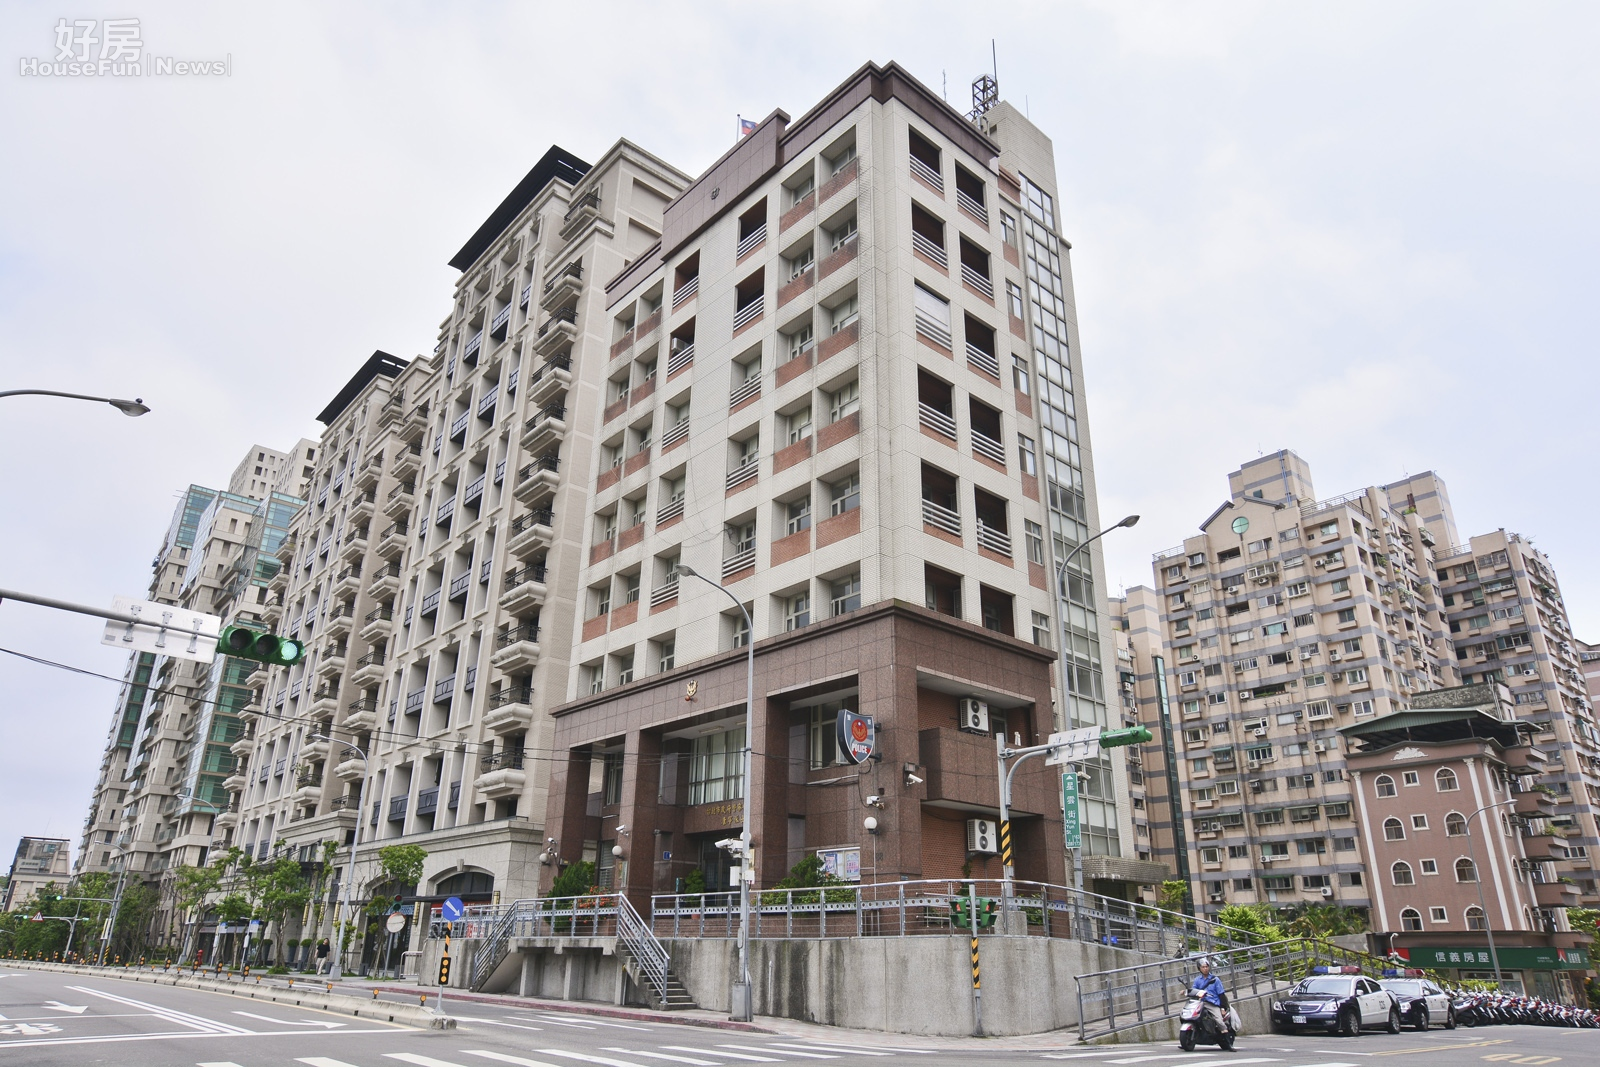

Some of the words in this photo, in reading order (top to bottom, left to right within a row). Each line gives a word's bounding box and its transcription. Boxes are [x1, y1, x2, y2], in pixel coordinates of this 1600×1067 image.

[851, 743, 868, 754] POLICE
[1066, 781, 1076, 819] 星雲街
[1435, 952, 1490, 963] 信義房屋
